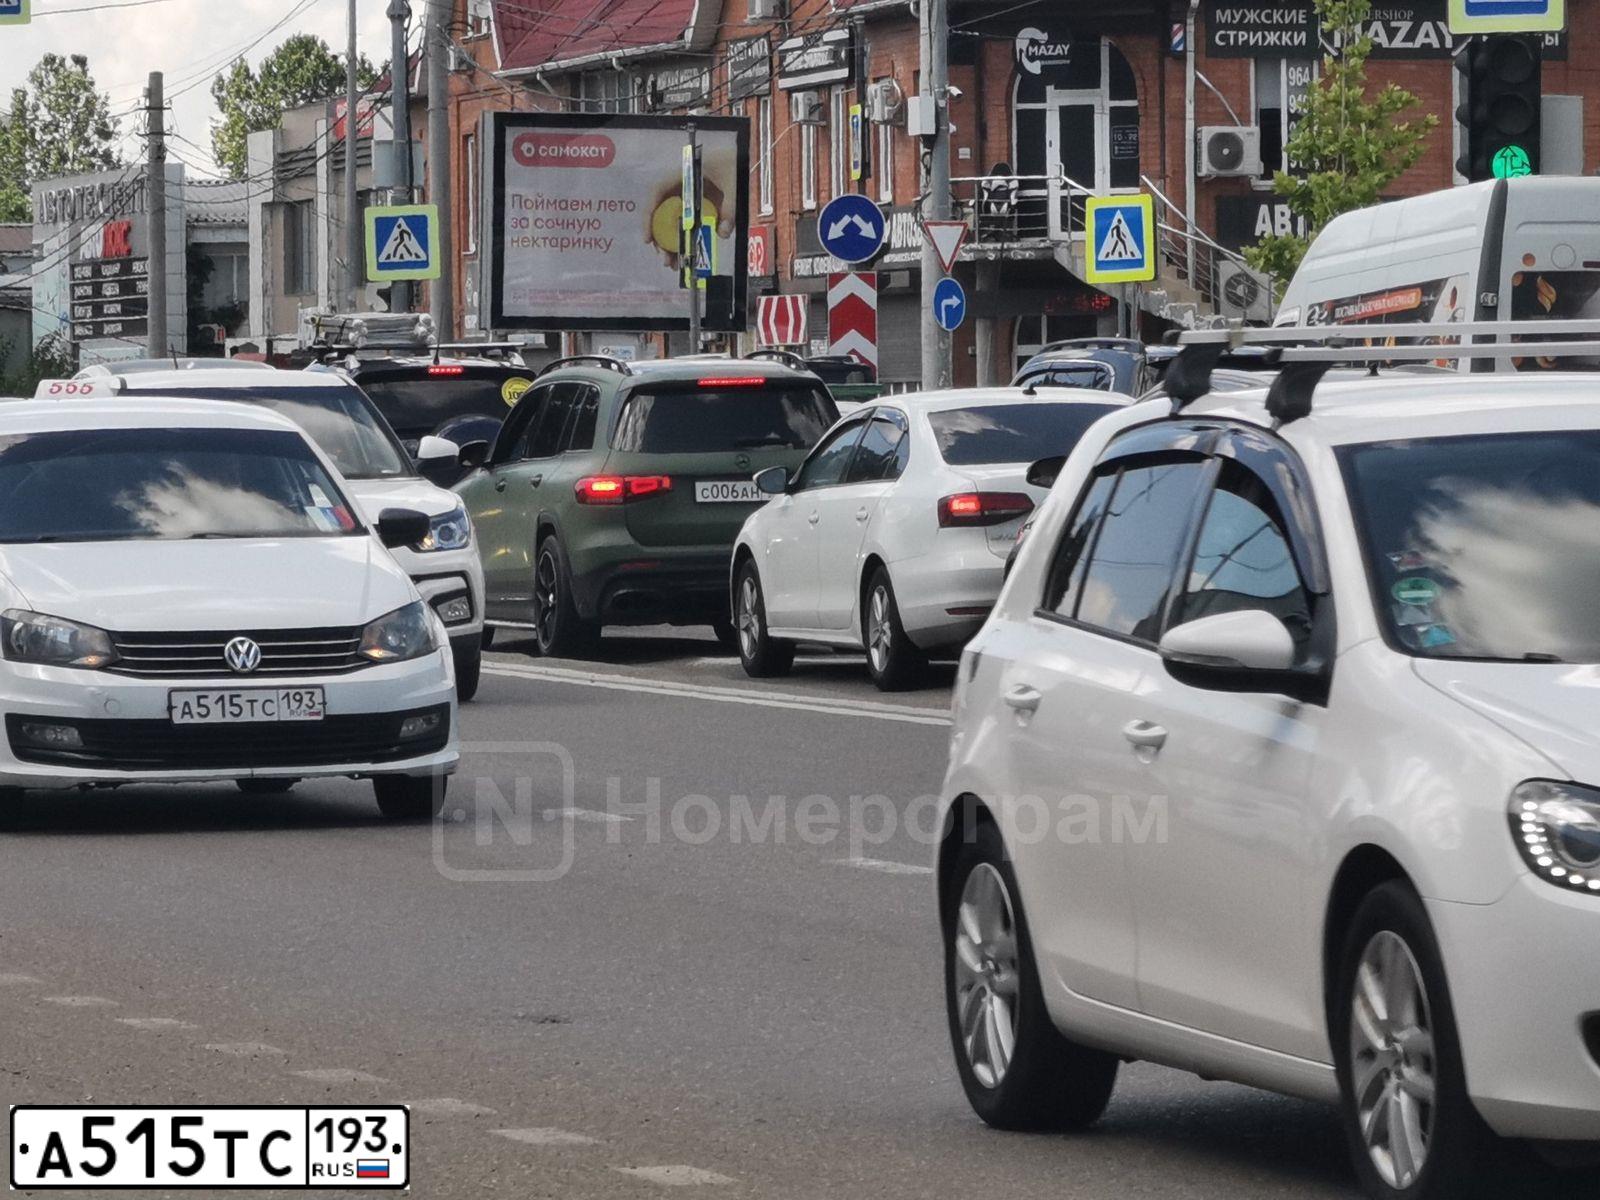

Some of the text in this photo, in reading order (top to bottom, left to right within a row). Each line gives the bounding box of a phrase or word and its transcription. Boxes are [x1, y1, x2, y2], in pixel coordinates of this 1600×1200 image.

[1215, 8, 1308, 24] МУЖСКИЕ
[1214, 30, 1307, 47] СТРИЖКИ
[1028, 44, 1070, 56] MAZAY
[1288, 66, 1310, 86] 964
[538, 145, 608, 158] самокат
[511, 193, 637, 213] Поймаем лето
[511, 217, 602, 234] за сочную
[511, 235, 614, 253] нектаринку
[180, 691, 316, 719] А515ТС 193
